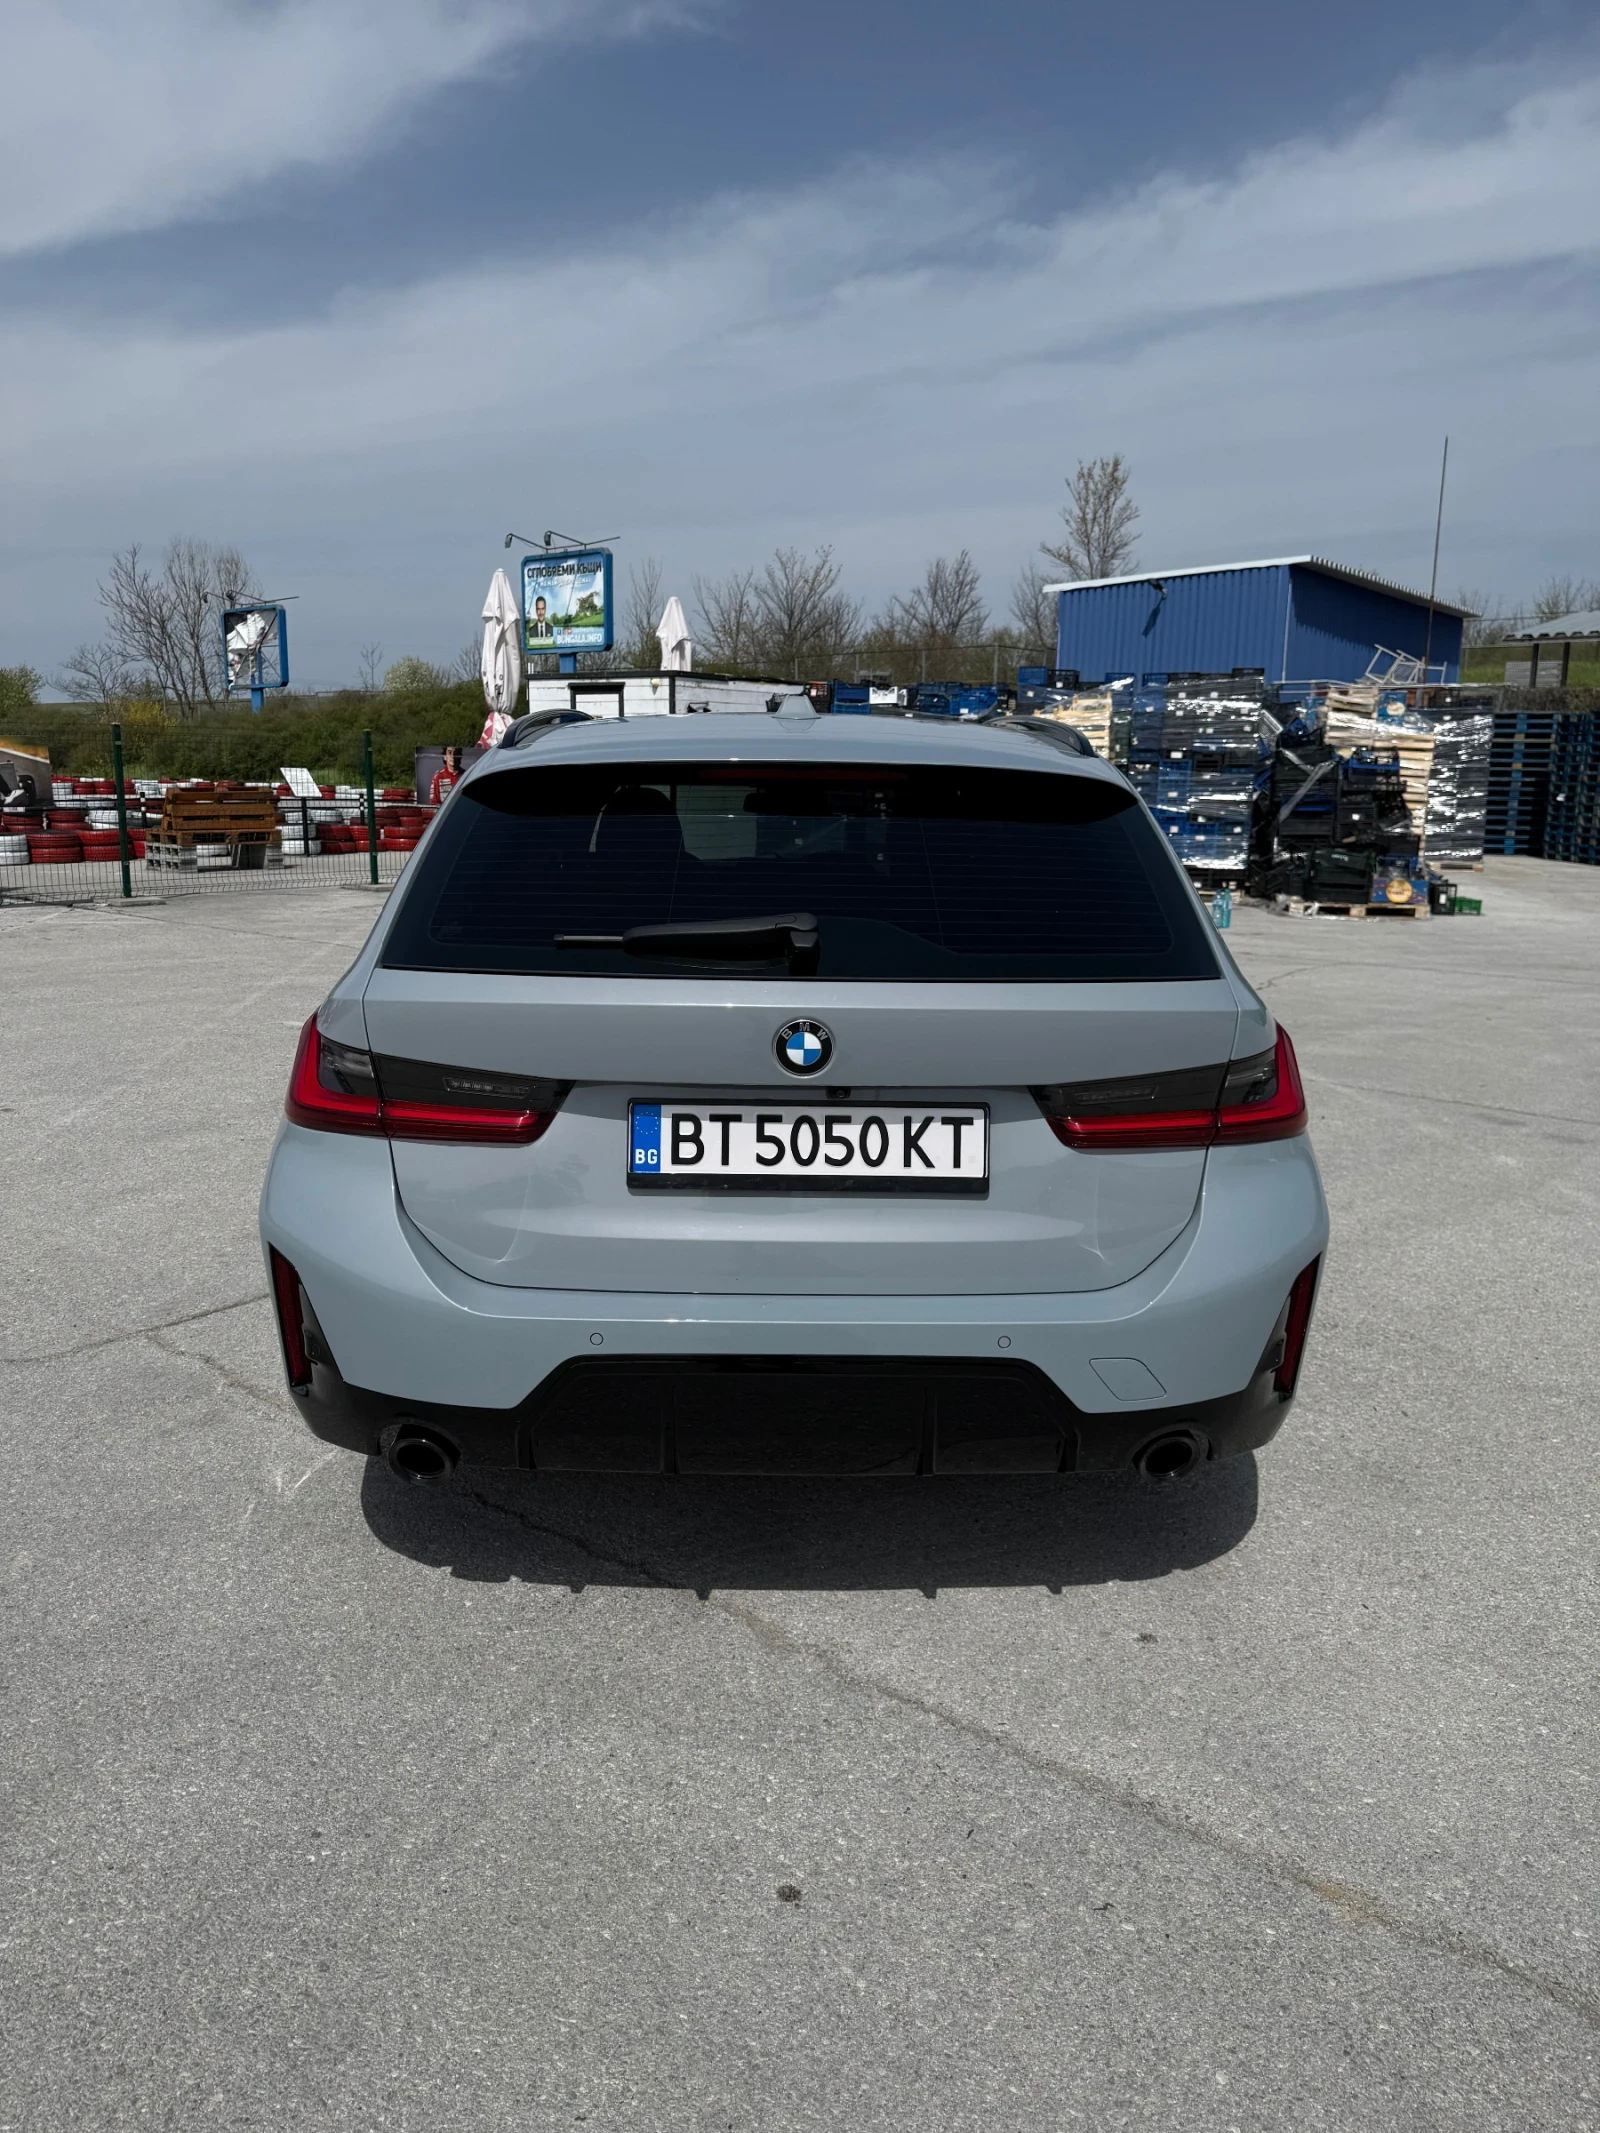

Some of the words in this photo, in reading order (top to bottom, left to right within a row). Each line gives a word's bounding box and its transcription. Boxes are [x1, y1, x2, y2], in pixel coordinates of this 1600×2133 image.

[527, 564, 575, 579] СГЛОБЯЕМИ
[577, 562, 602, 576] КЪЩИ
[781, 1022, 828, 1041] BMW
[671, 1113, 743, 1166] BT
[756, 1114, 890, 1168] 5050
[904, 1116, 974, 1169] KT
[635, 1149, 658, 1164] BG
